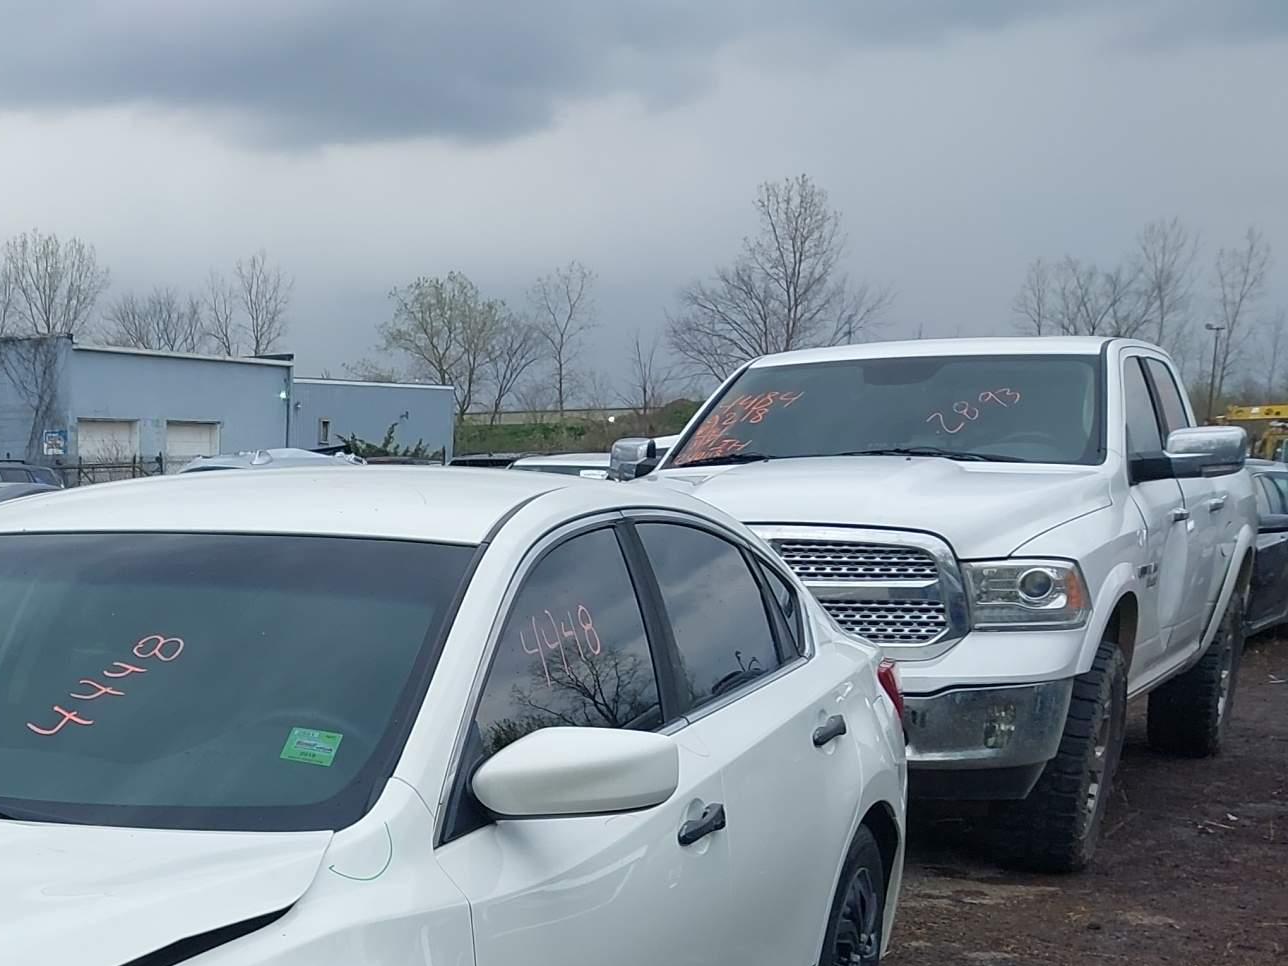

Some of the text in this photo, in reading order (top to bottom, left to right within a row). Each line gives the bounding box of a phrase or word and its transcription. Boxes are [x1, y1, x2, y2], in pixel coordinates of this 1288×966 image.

[925, 387, 1020, 433] 2893
[26, 634, 185, 735] 4448
[519, 604, 601, 688] 4448
